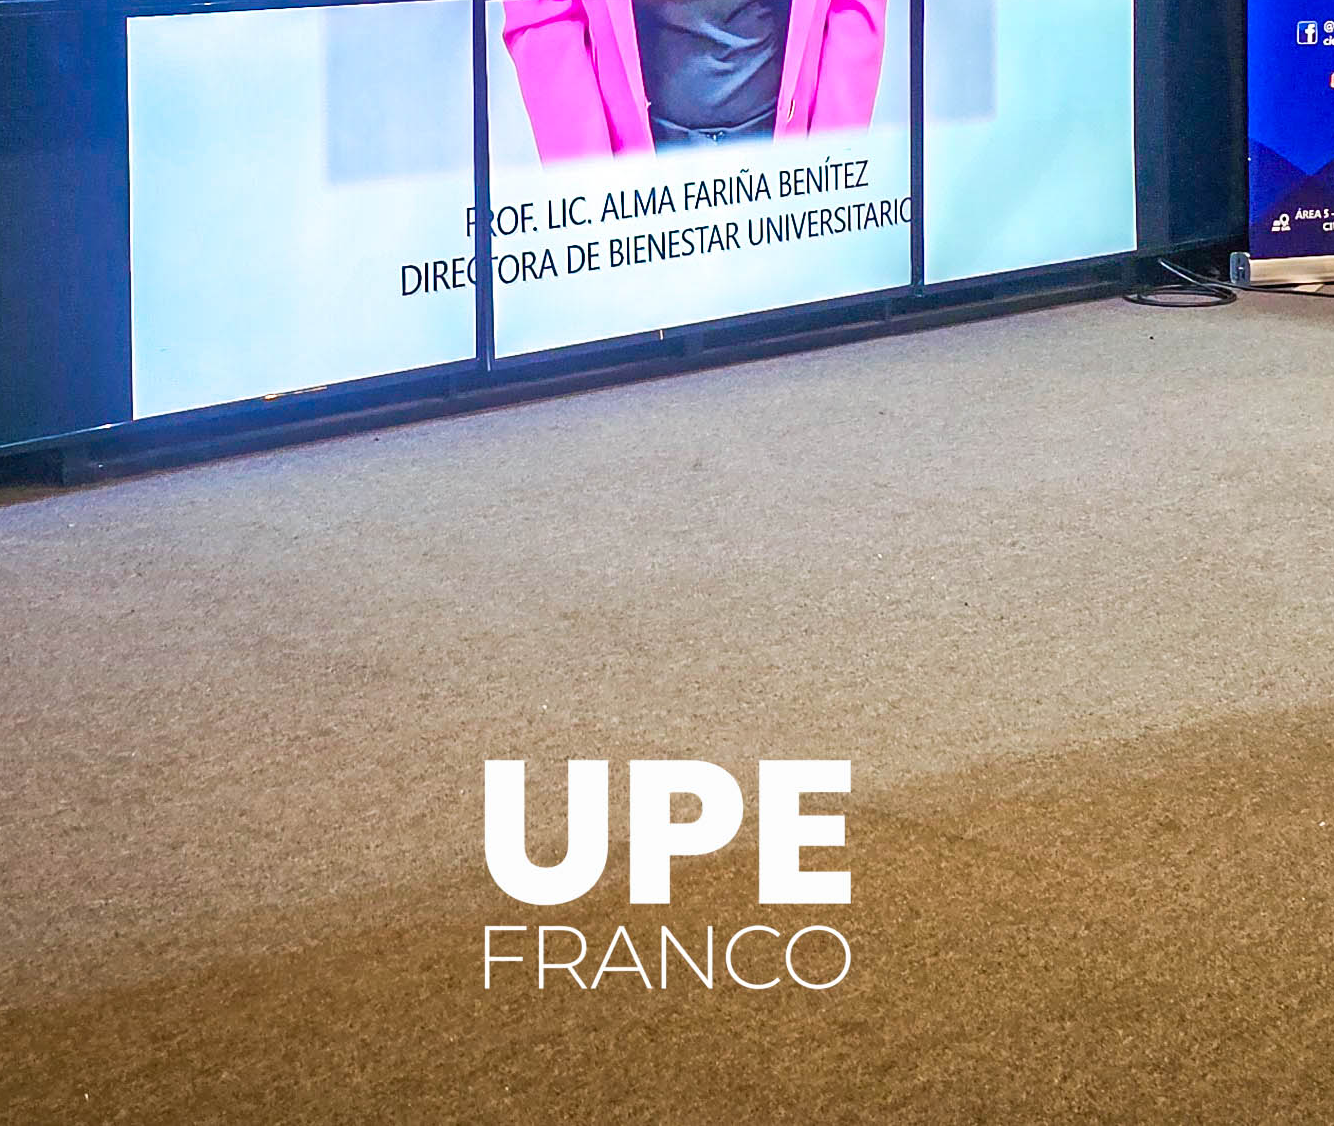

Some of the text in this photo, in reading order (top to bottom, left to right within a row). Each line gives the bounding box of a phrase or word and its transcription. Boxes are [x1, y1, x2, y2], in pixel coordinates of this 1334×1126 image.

[548, 196, 591, 229] LIC.
[601, 186, 676, 222] ALMA
[683, 169, 769, 211] FARIÑA
[779, 156, 869, 196] BENÍTEZ
[1295, 207, 1321, 219] ÁREA
[567, 242, 602, 273] DE
[609, 222, 740, 267] BIENESTAR
